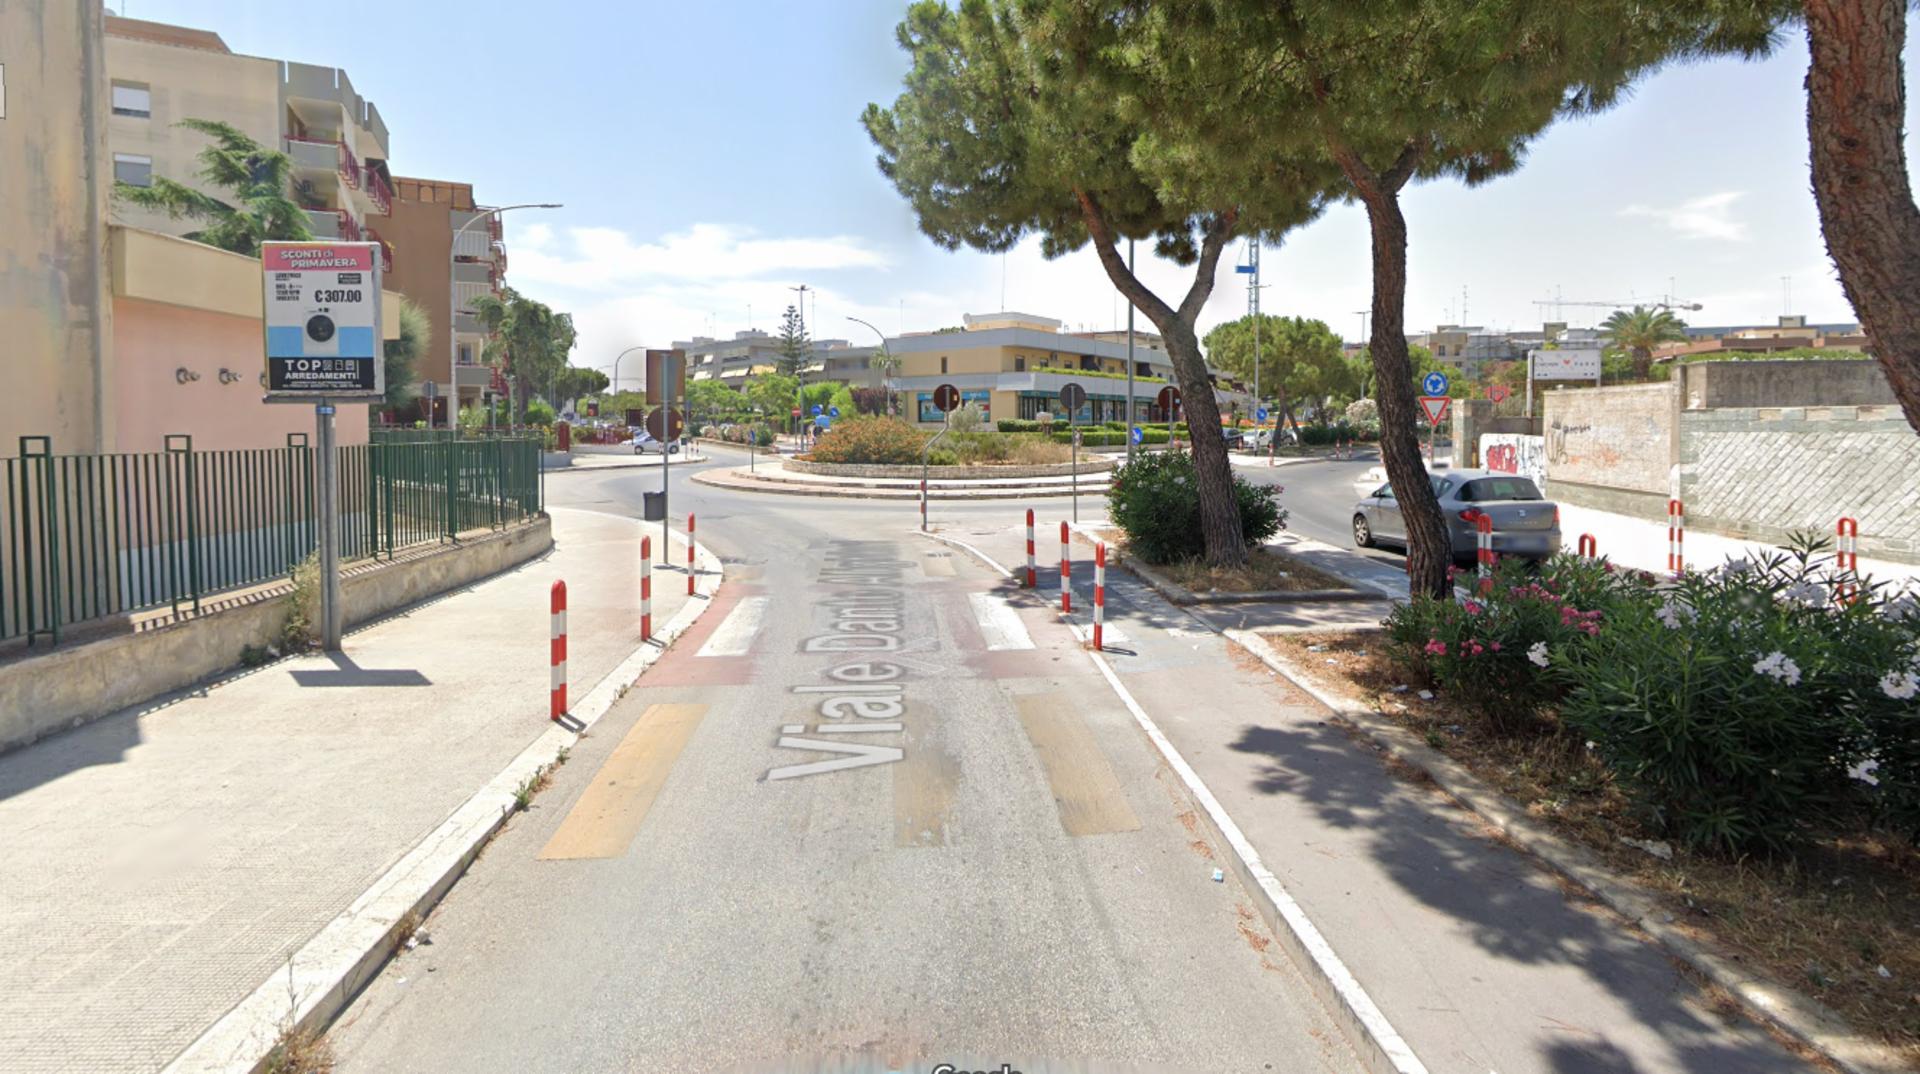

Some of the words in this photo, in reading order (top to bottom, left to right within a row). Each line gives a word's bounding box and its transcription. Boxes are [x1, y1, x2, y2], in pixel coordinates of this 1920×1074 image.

[280, 250, 322, 260] SCONTI
[323, 249, 334, 258] di
[291, 258, 358, 269] PRIMAVERA
[314, 289, 323, 303] €
[324, 289, 362, 303] 307.00
[284, 359, 321, 372] TOP
[284, 372, 357, 380] ARREDAMENTI
